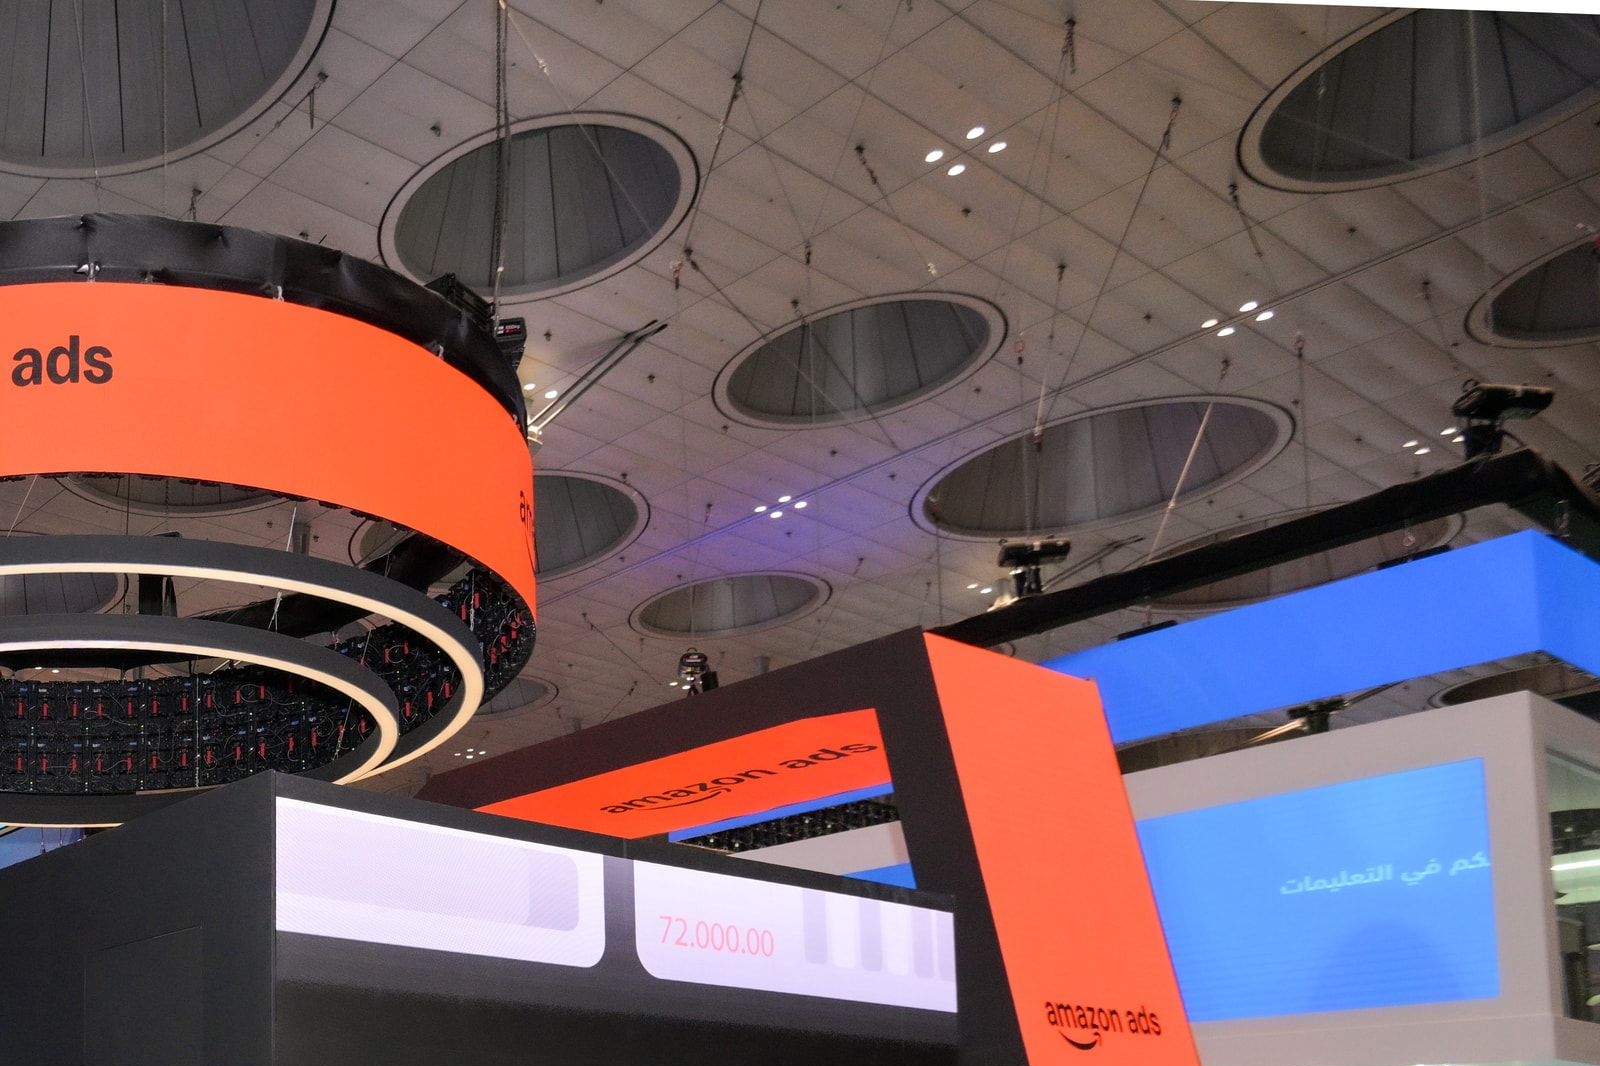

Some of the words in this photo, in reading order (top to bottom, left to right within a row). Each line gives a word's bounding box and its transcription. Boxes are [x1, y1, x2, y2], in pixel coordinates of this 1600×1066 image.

[11, 335, 114, 387] ads
[600, 769, 777, 814] amazon
[779, 743, 878, 769] ads
[1280, 864, 1393, 894] التعليمات
[1400, 858, 1442, 886] في
[659, 915, 775, 957] 72.000.00
[1045, 1001, 1123, 1032] amazon
[1126, 1005, 1161, 1036] ads
